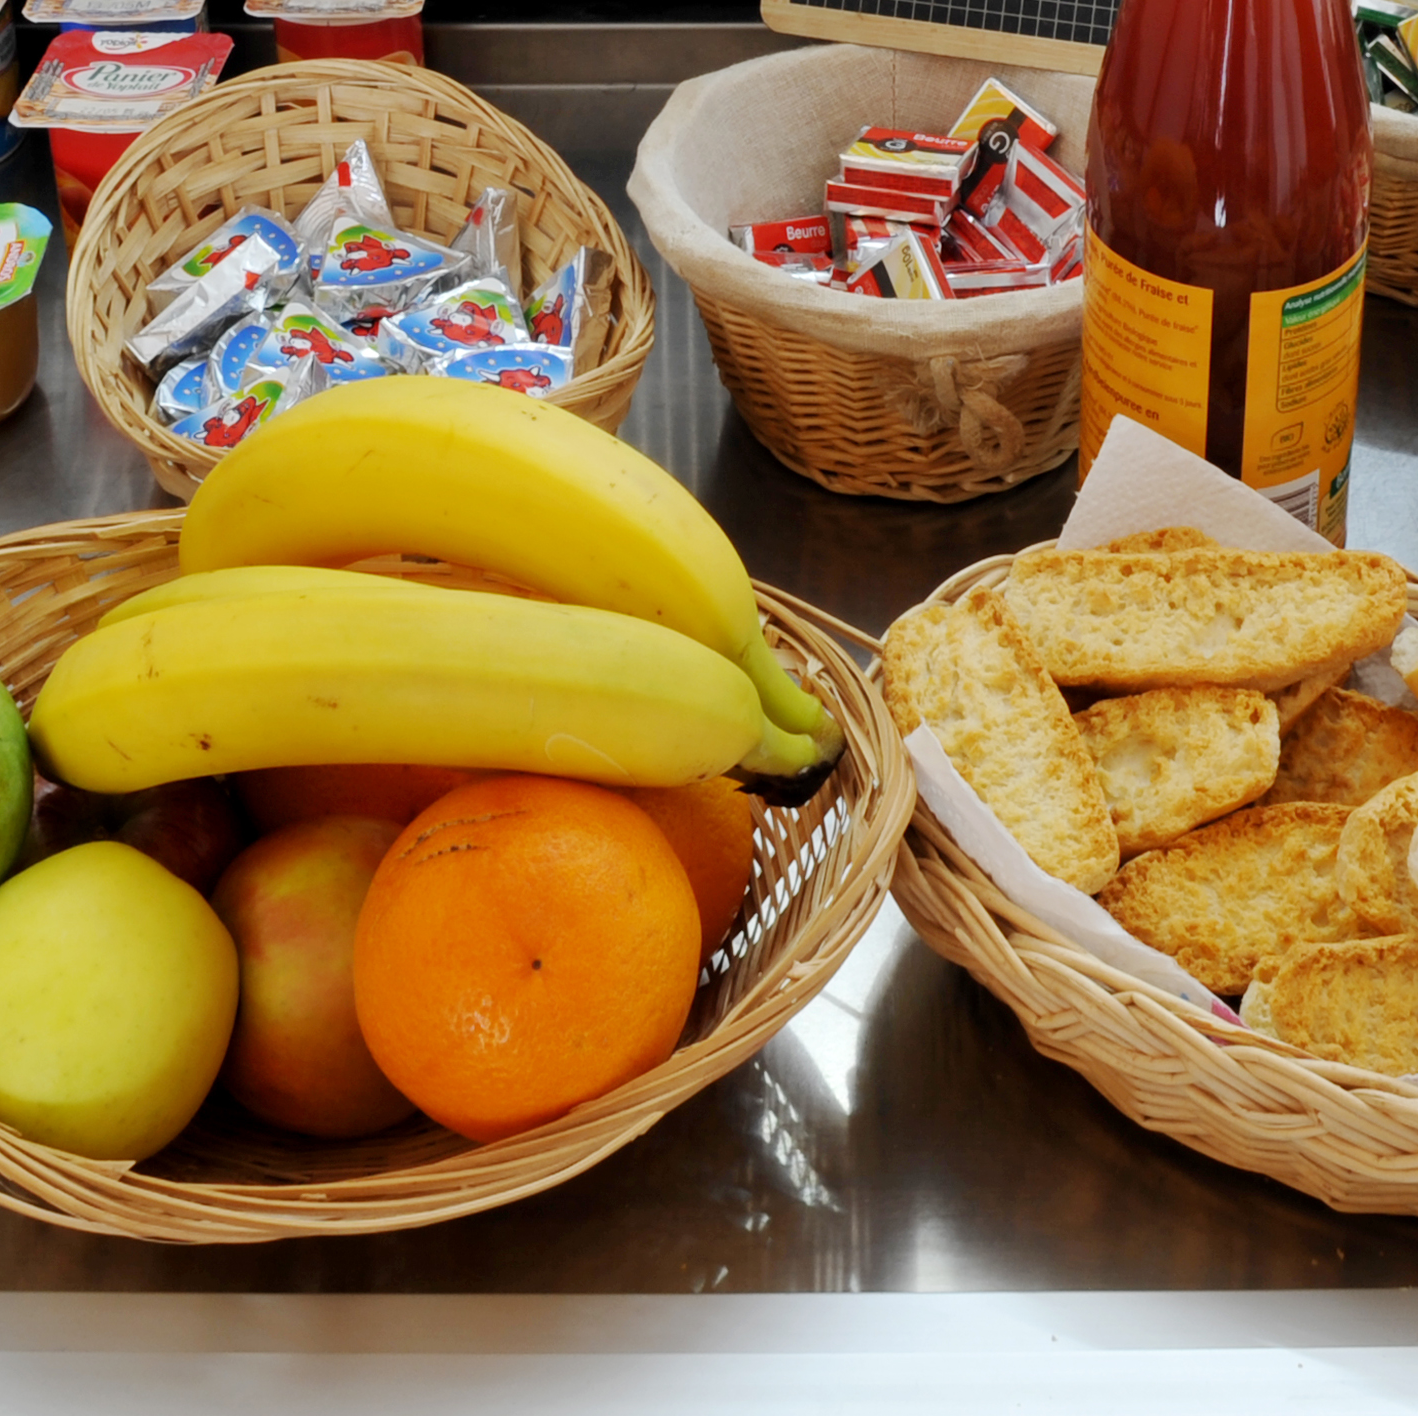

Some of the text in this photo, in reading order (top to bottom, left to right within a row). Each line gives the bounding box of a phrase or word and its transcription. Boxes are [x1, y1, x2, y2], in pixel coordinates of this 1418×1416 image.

[87, 63, 178, 83] Panier
[106, 81, 161, 92] Yoplait
[913, 132, 969, 148] Beurre
[786, 224, 827, 240] Beurre
[1126, 271, 1139, 287] de
[1140, 279, 1174, 302] Fraise
[1176, 293, 1190, 307] et
